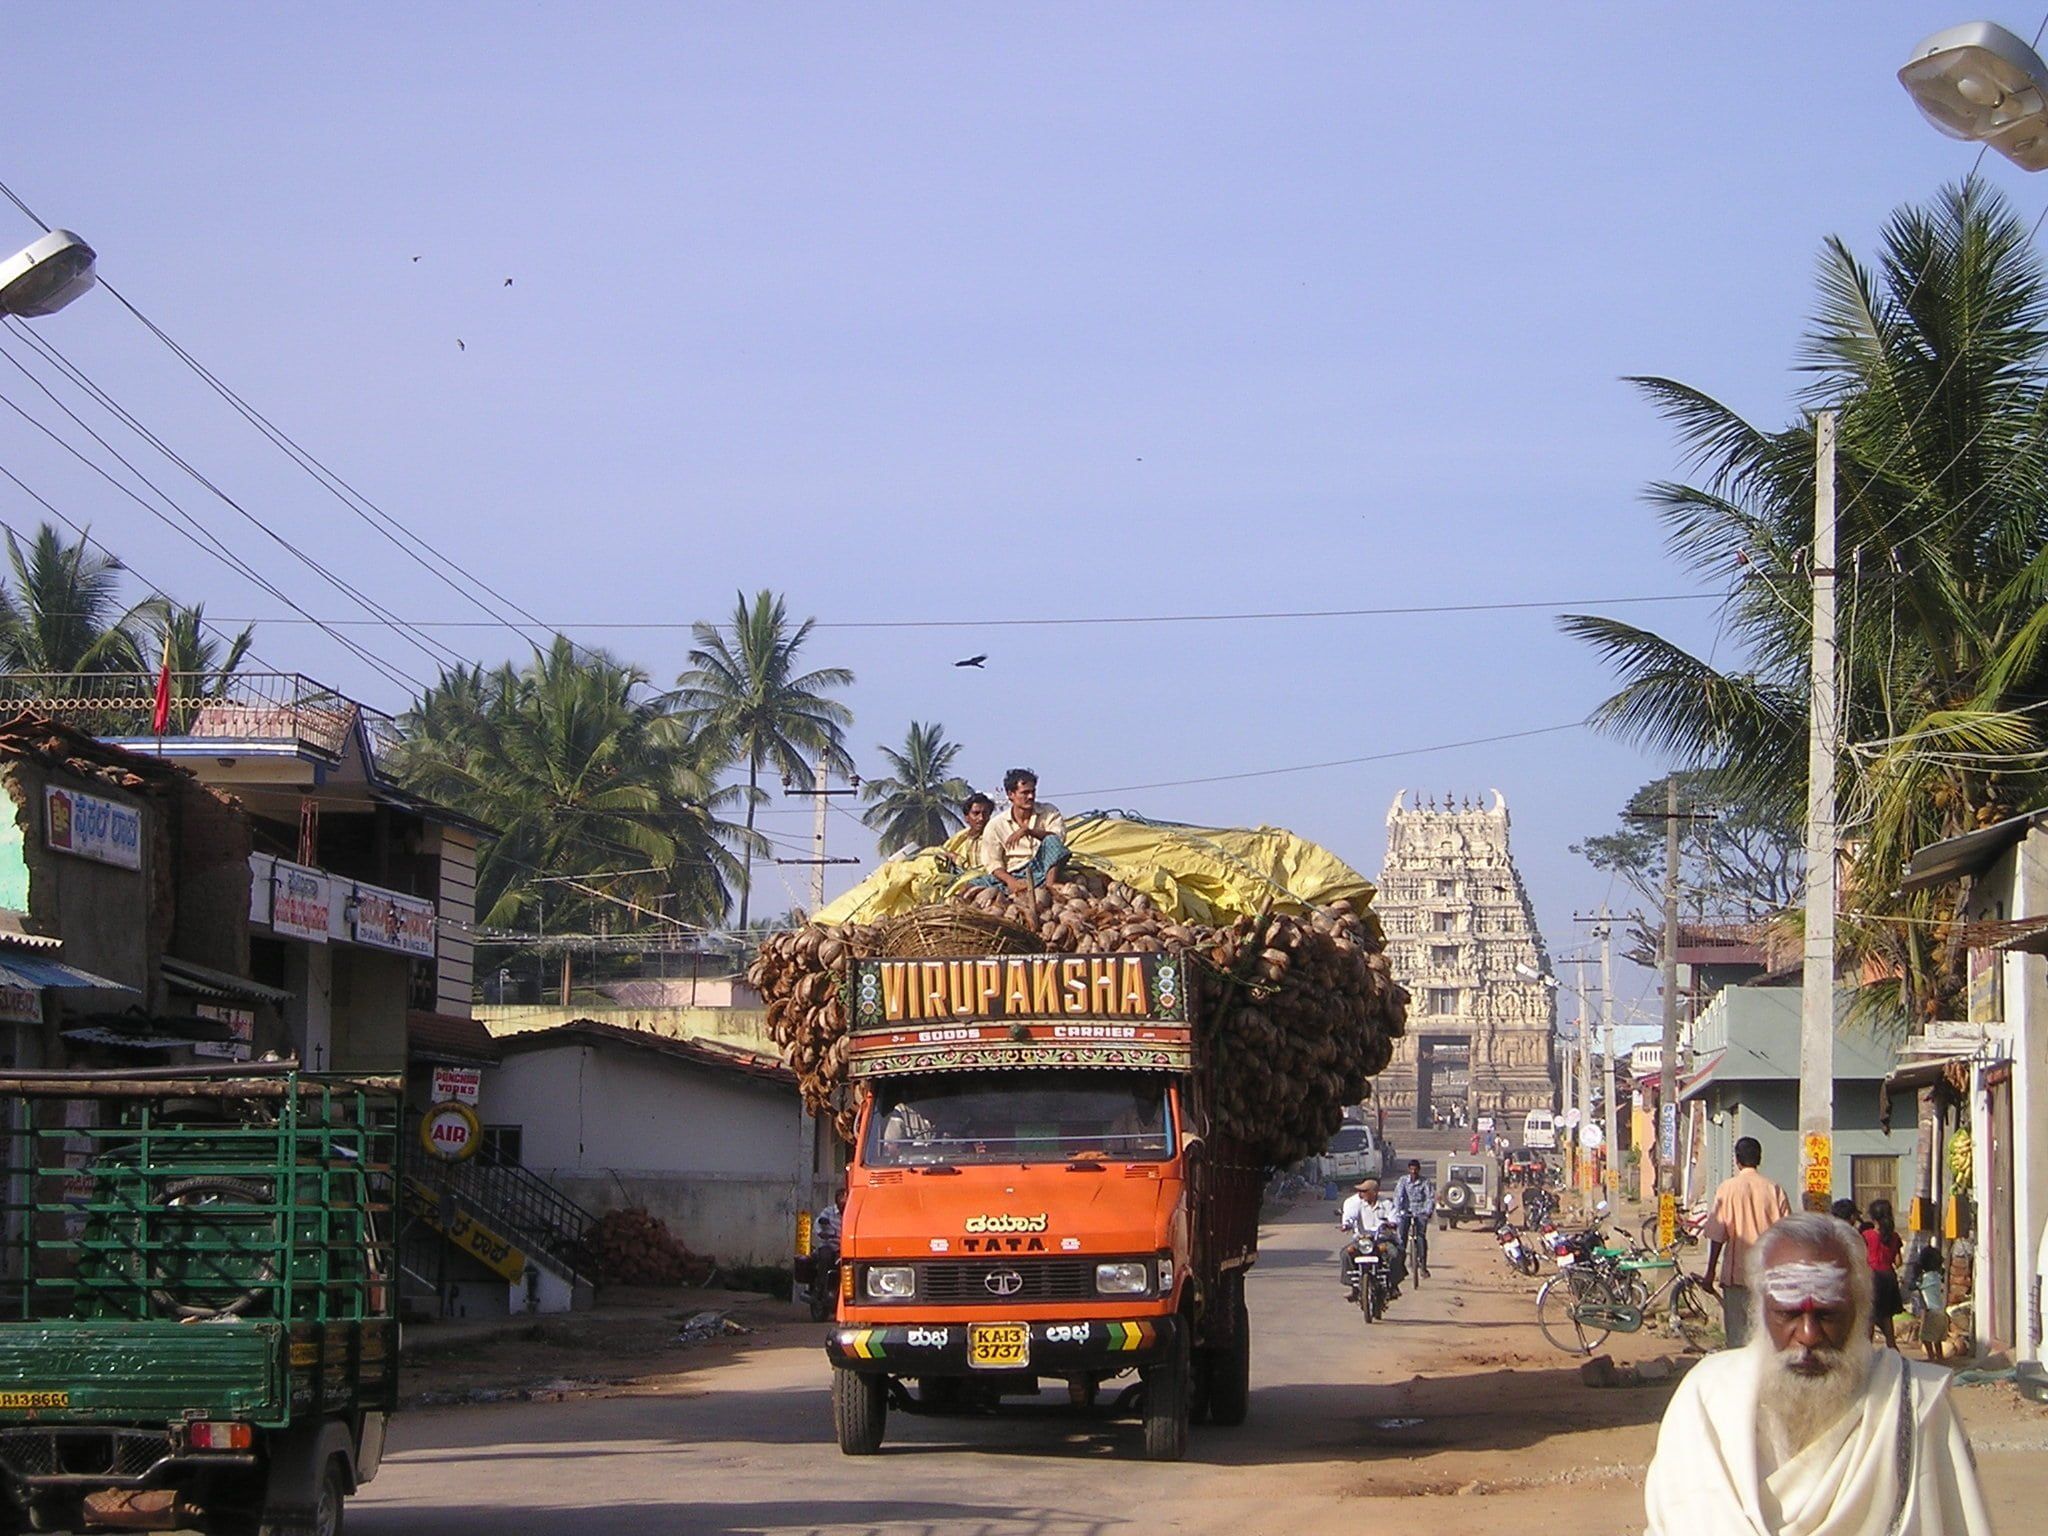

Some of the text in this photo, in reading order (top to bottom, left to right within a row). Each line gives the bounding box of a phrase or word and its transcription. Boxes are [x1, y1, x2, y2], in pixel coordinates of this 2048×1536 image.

[880, 957, 1148, 1021] VIRUPAKSHA
[918, 1028, 981, 1042] GOODS
[1054, 1026, 1136, 1038] CARRIER
[432, 1124, 467, 1142] AIR
[964, 1239, 1044, 1252] TATA
[907, 1321, 1091, 1350] ಶುಭ ಲಾಭ
[977, 1344, 1021, 1359] 3737
